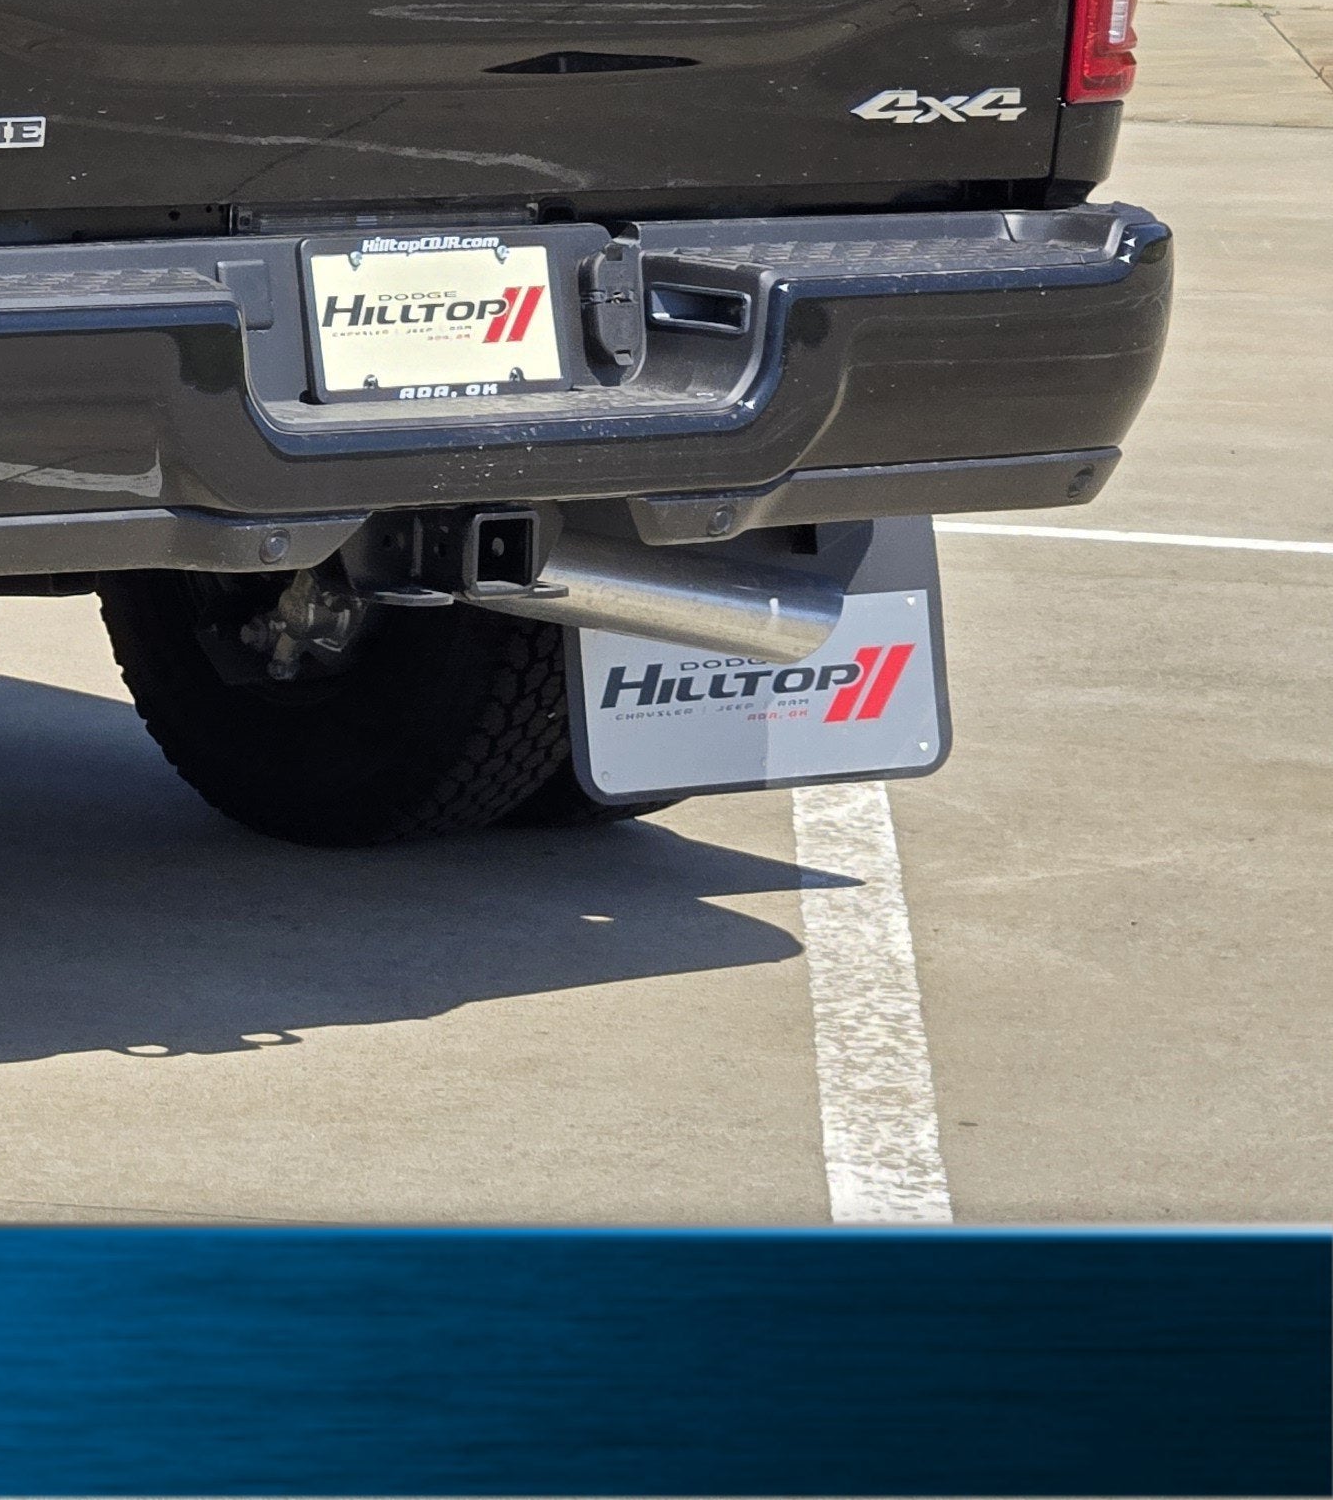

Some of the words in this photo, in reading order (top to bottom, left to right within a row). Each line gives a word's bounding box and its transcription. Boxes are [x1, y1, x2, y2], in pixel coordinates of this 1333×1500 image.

[849, 87, 1027, 124] 4x4
[361, 236, 500, 254] HilltopCDJR.com
[377, 290, 458, 302] DODGE
[321, 294, 508, 328] HILLTOP
[398, 385, 458, 400] ADA,
[464, 383, 499, 396] OK
[679, 657, 768, 671] DODG
[600, 662, 861, 709] HILLTOP
